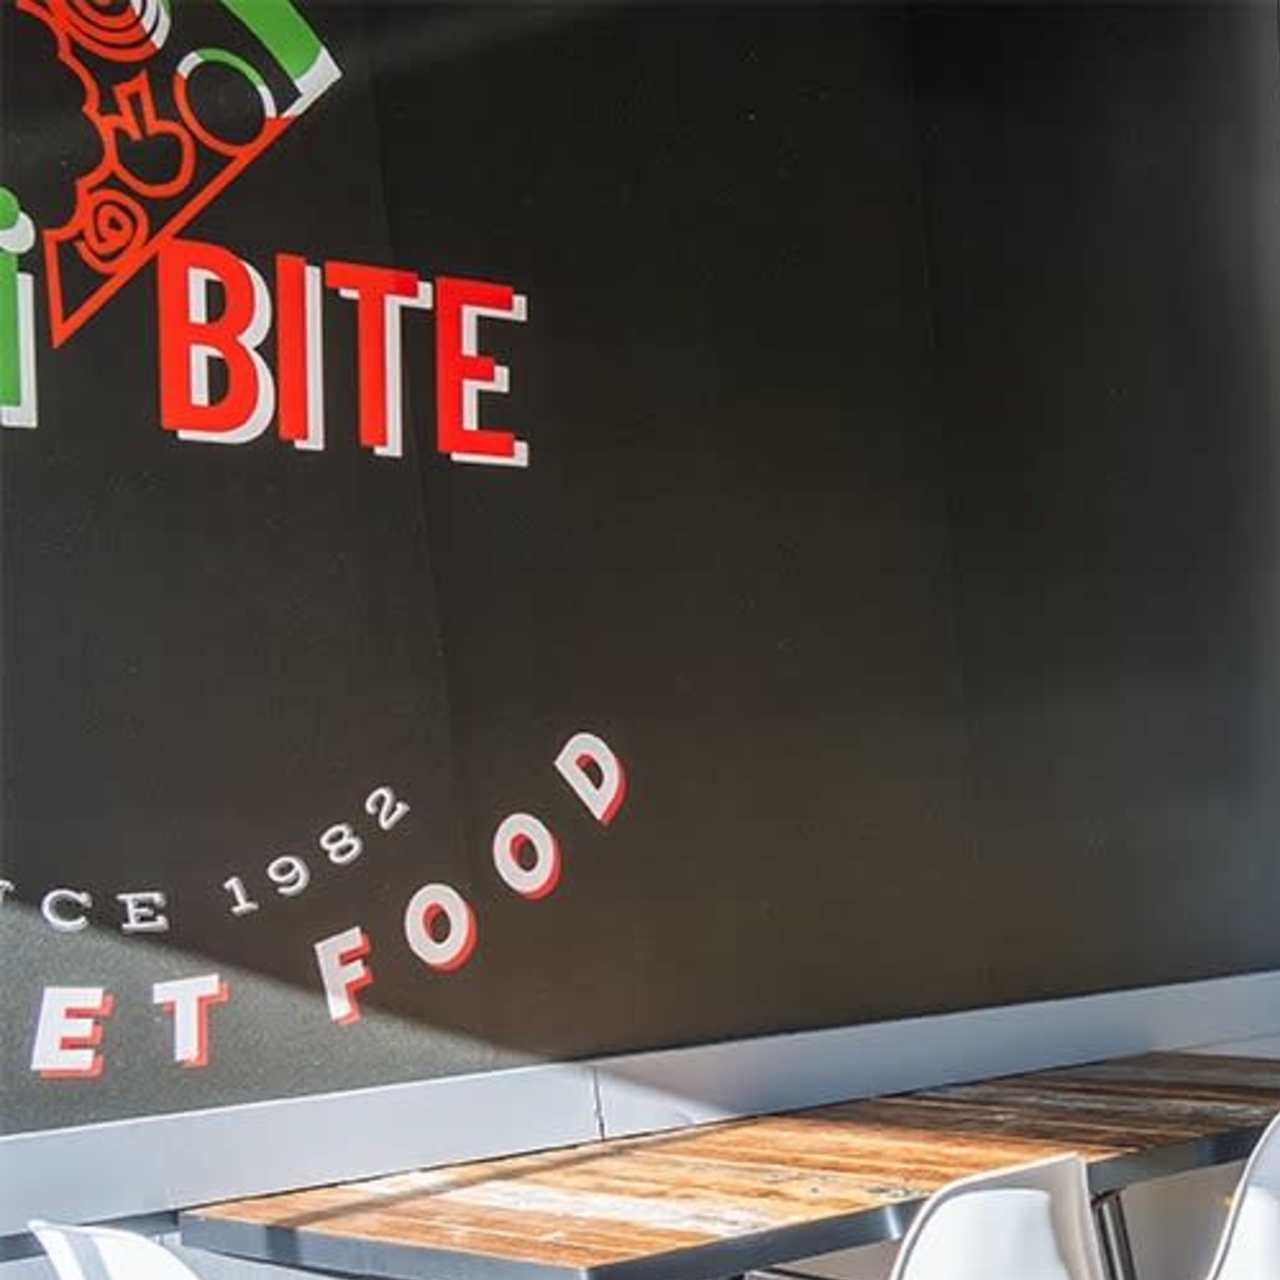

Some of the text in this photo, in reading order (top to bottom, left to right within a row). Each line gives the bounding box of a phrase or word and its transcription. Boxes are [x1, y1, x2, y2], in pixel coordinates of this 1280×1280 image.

[157, 237, 529, 467] BITE
[0, 787, 409, 932] CE 1982
[31, 732, 627, 1079] ET FOOD
